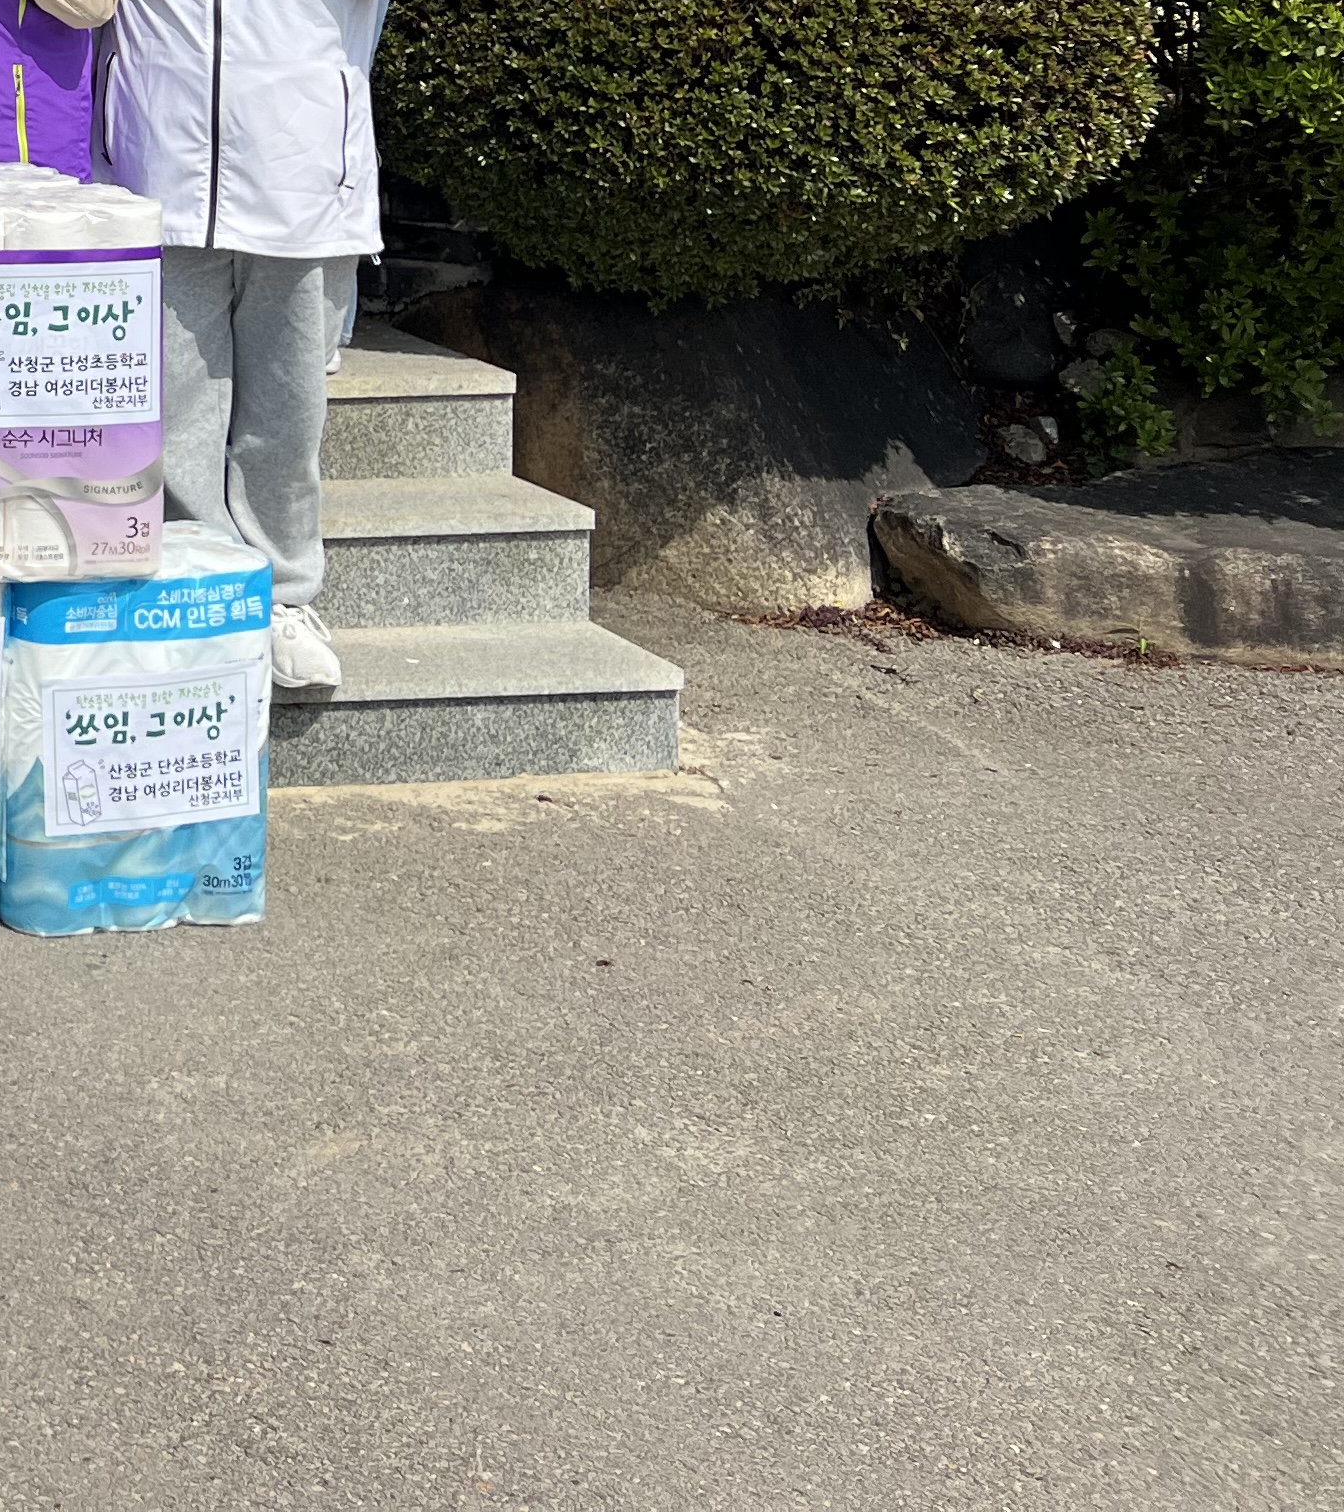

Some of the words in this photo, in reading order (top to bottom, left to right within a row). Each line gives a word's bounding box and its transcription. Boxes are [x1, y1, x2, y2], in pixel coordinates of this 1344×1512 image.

[20, 284, 50, 300] 실천을
[54, 283, 77, 298] 위한
[82, 279, 129, 295] 자원순환
[8, 357, 54, 373] 산청군
[61, 353, 147, 372] 단성초등학교
[9, 380, 39, 396] 경남
[45, 376, 147, 395] 여성리더봉사단
[92, 395, 147, 409] 산청군지부
[2, 429, 34, 448] 순수
[38, 428, 103, 447] 시그니처
[83, 481, 144, 494] SIGNATURE
[125, 517, 150, 538] 3겹
[157, 583, 244, 605] 소비자중심경영
[65, 605, 117, 620] 소비자중심
[134, 608, 180, 629] CCM
[187, 604, 226, 628] 인증
[231, 596, 263, 621] 획득
[108, 763, 153, 779] 산청군
[158, 750, 242, 775] 단성초등학교
[109, 786, 138, 802] 경남
[144, 771, 243, 798] 여성리더봉사단
[189, 789, 243, 807] 산청군지부
